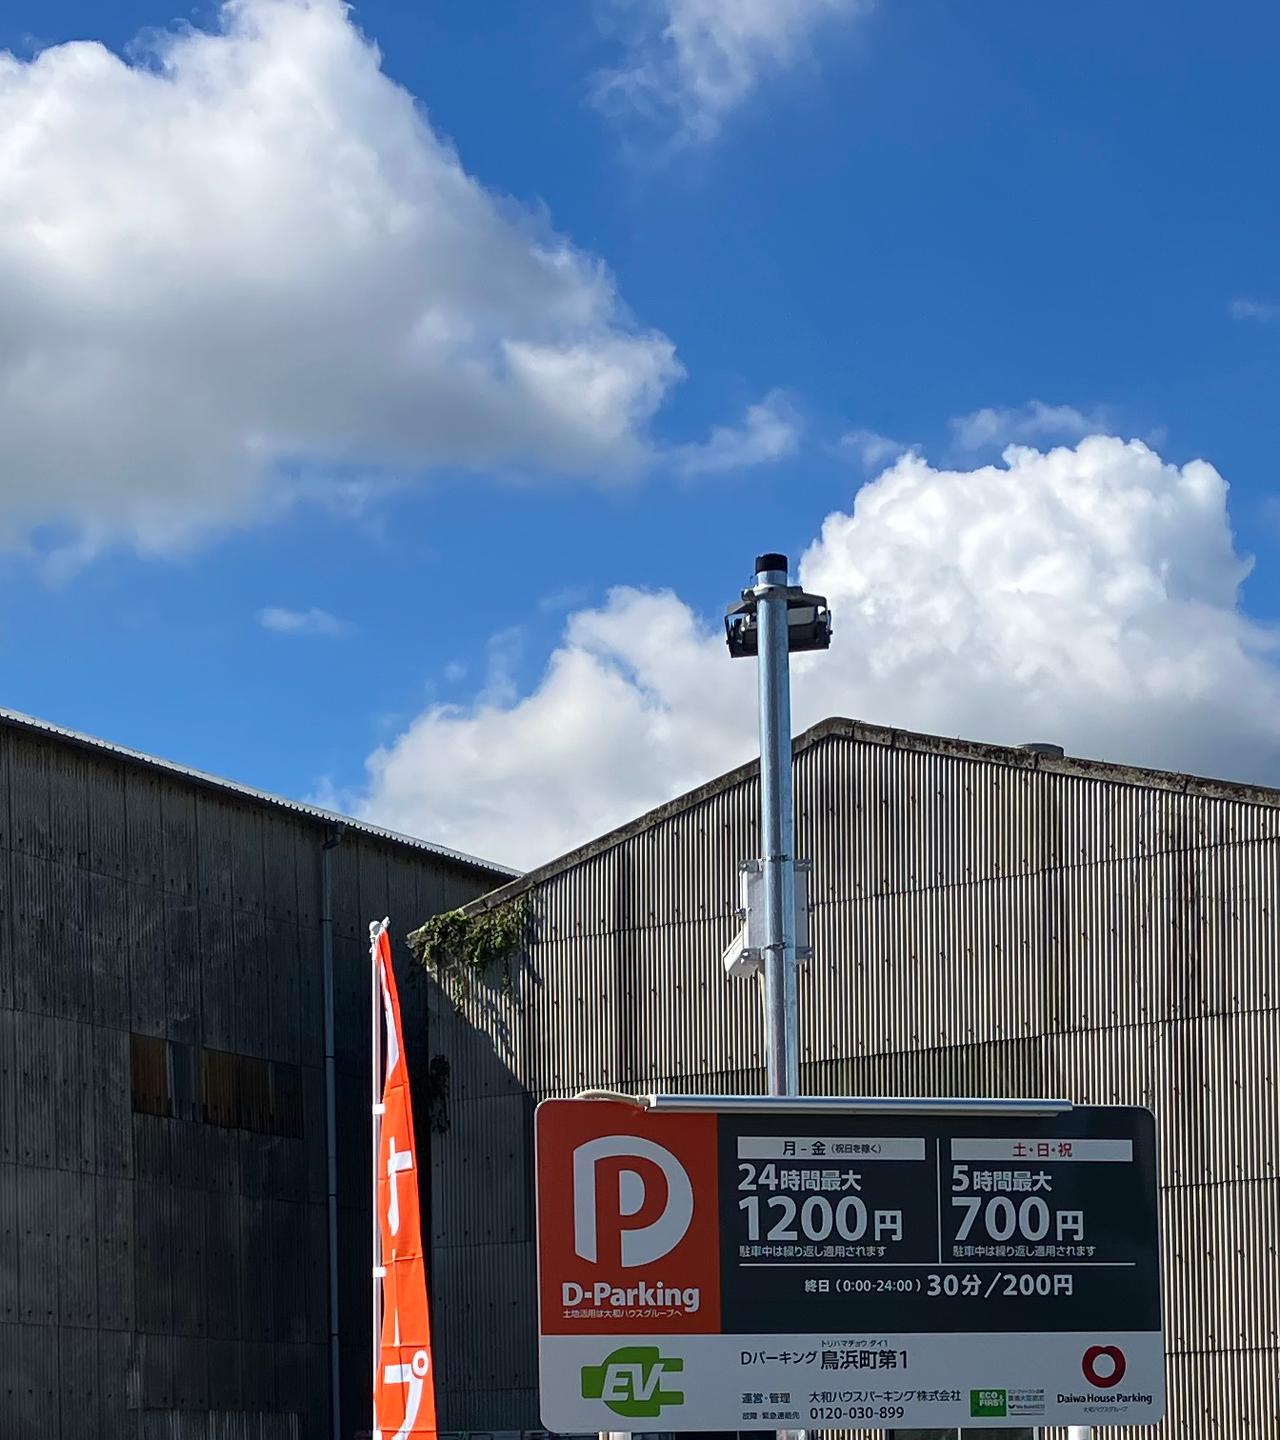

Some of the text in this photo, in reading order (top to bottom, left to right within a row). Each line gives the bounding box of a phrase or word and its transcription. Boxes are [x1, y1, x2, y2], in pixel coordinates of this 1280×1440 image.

[1013, 1143, 1073, 1157] 土・日・祝
[738, 1163, 862, 1191] 24時間最大
[952, 1165, 1052, 1191] 5時間最大
[738, 1195, 902, 1241] 1200円
[952, 1196, 1084, 1241] 700円
[739, 1245, 887, 1258] 駐車中は繰り返し適用されます
[953, 1245, 1096, 1257] 駐車中は繰り返し適用されます
[927, 1272, 1073, 1298] 30分/200円
[561, 1281, 700, 1312] D-Parking
[562, 1308, 682, 1319] 土地活用は大和ハウスグループへ
[741, 1350, 909, 1370] Dパーキング 鳥浜町第1
[601, 1363, 665, 1401] EV
[741, 1390, 961, 1404] 運営・管理 大和ハウスパーキング株式会社
[979, 1391, 998, 1399] ECO
[1057, 1393, 1086, 1404] Daiwa
[1087, 1393, 1115, 1403] House
[1116, 1393, 1153, 1405] Parking
[979, 1399, 1005, 1407] FIRST
[809, 1407, 905, 1420] 0120-030-899
